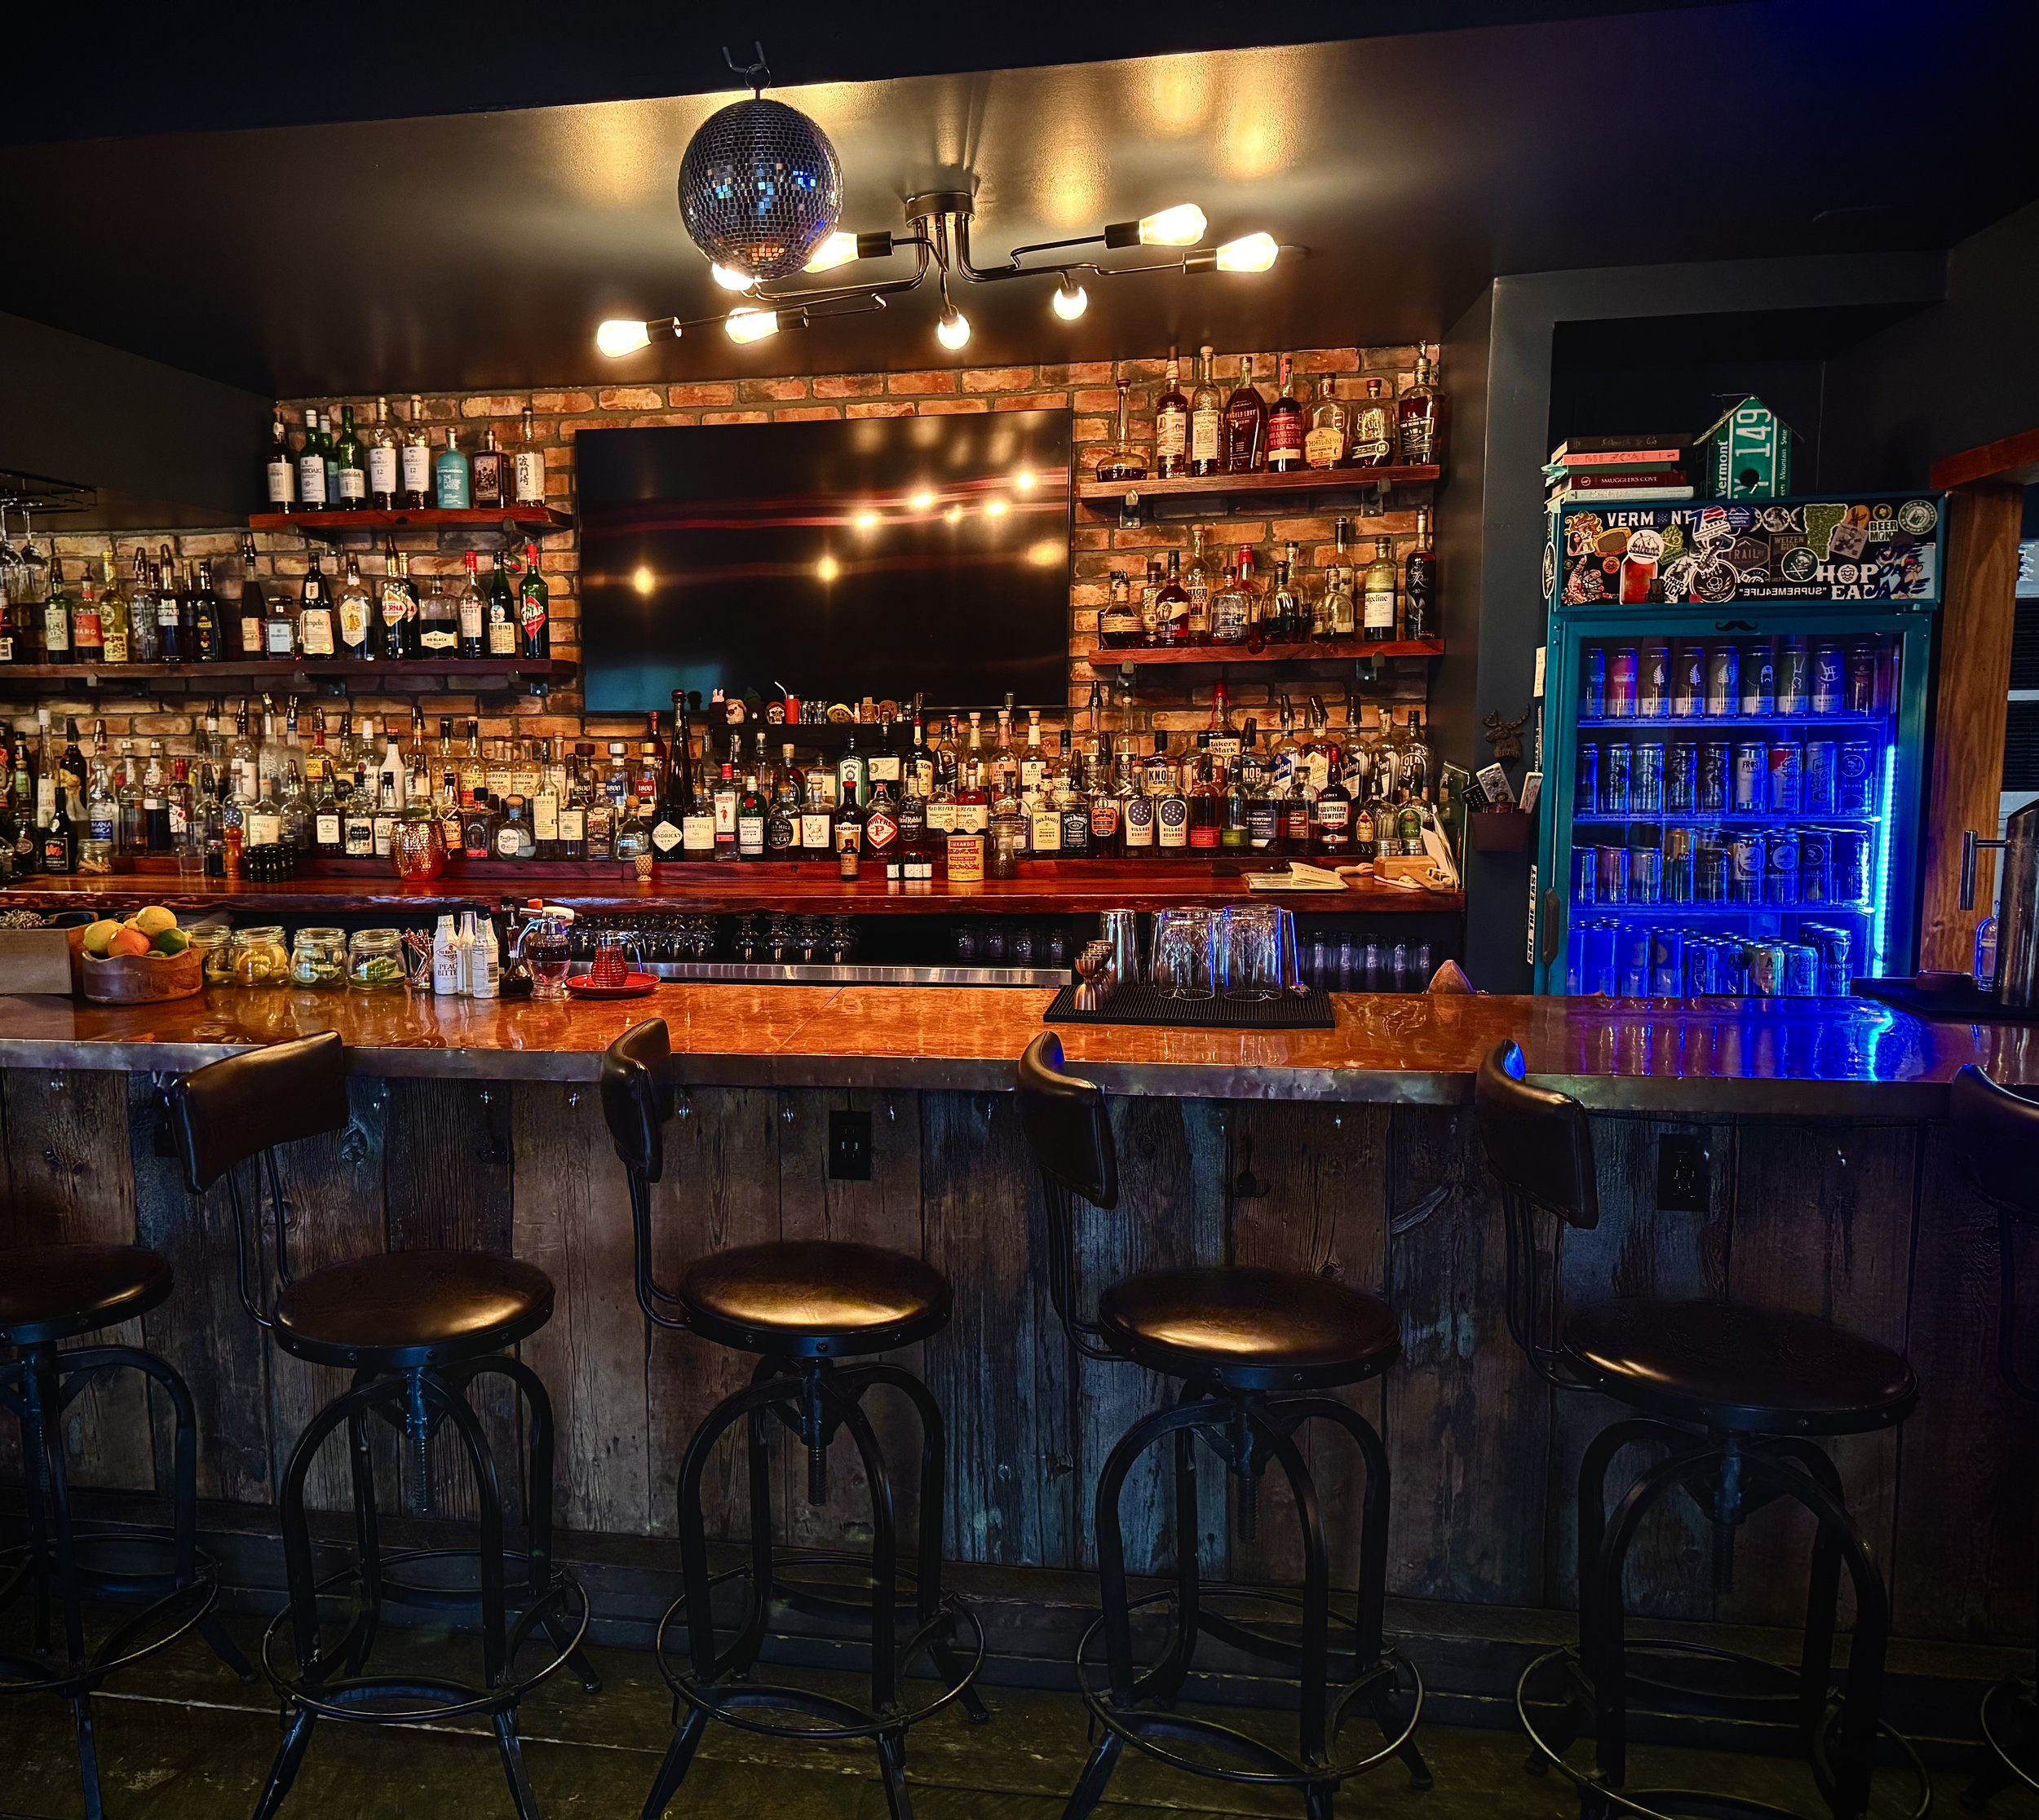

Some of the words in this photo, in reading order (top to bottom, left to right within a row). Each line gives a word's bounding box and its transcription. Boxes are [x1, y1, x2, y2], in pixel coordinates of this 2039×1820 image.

[1734, 408, 1772, 457] 149
[1715, 440, 1728, 497] Vermont
[1607, 510, 1692, 528] VERMNT
[1870, 523, 1898, 531] BEER
[1870, 532, 1893, 541] MON
[1817, 563, 1879, 585] HOP
[309, 586, 316, 596] F
[868, 816, 892, 827] POWERS
[1035, 817, 1045, 825] JACK
[1064, 816, 1073, 824] JACK
[588, 827, 609, 835] PAPILIO
[874, 825, 885, 837] P
